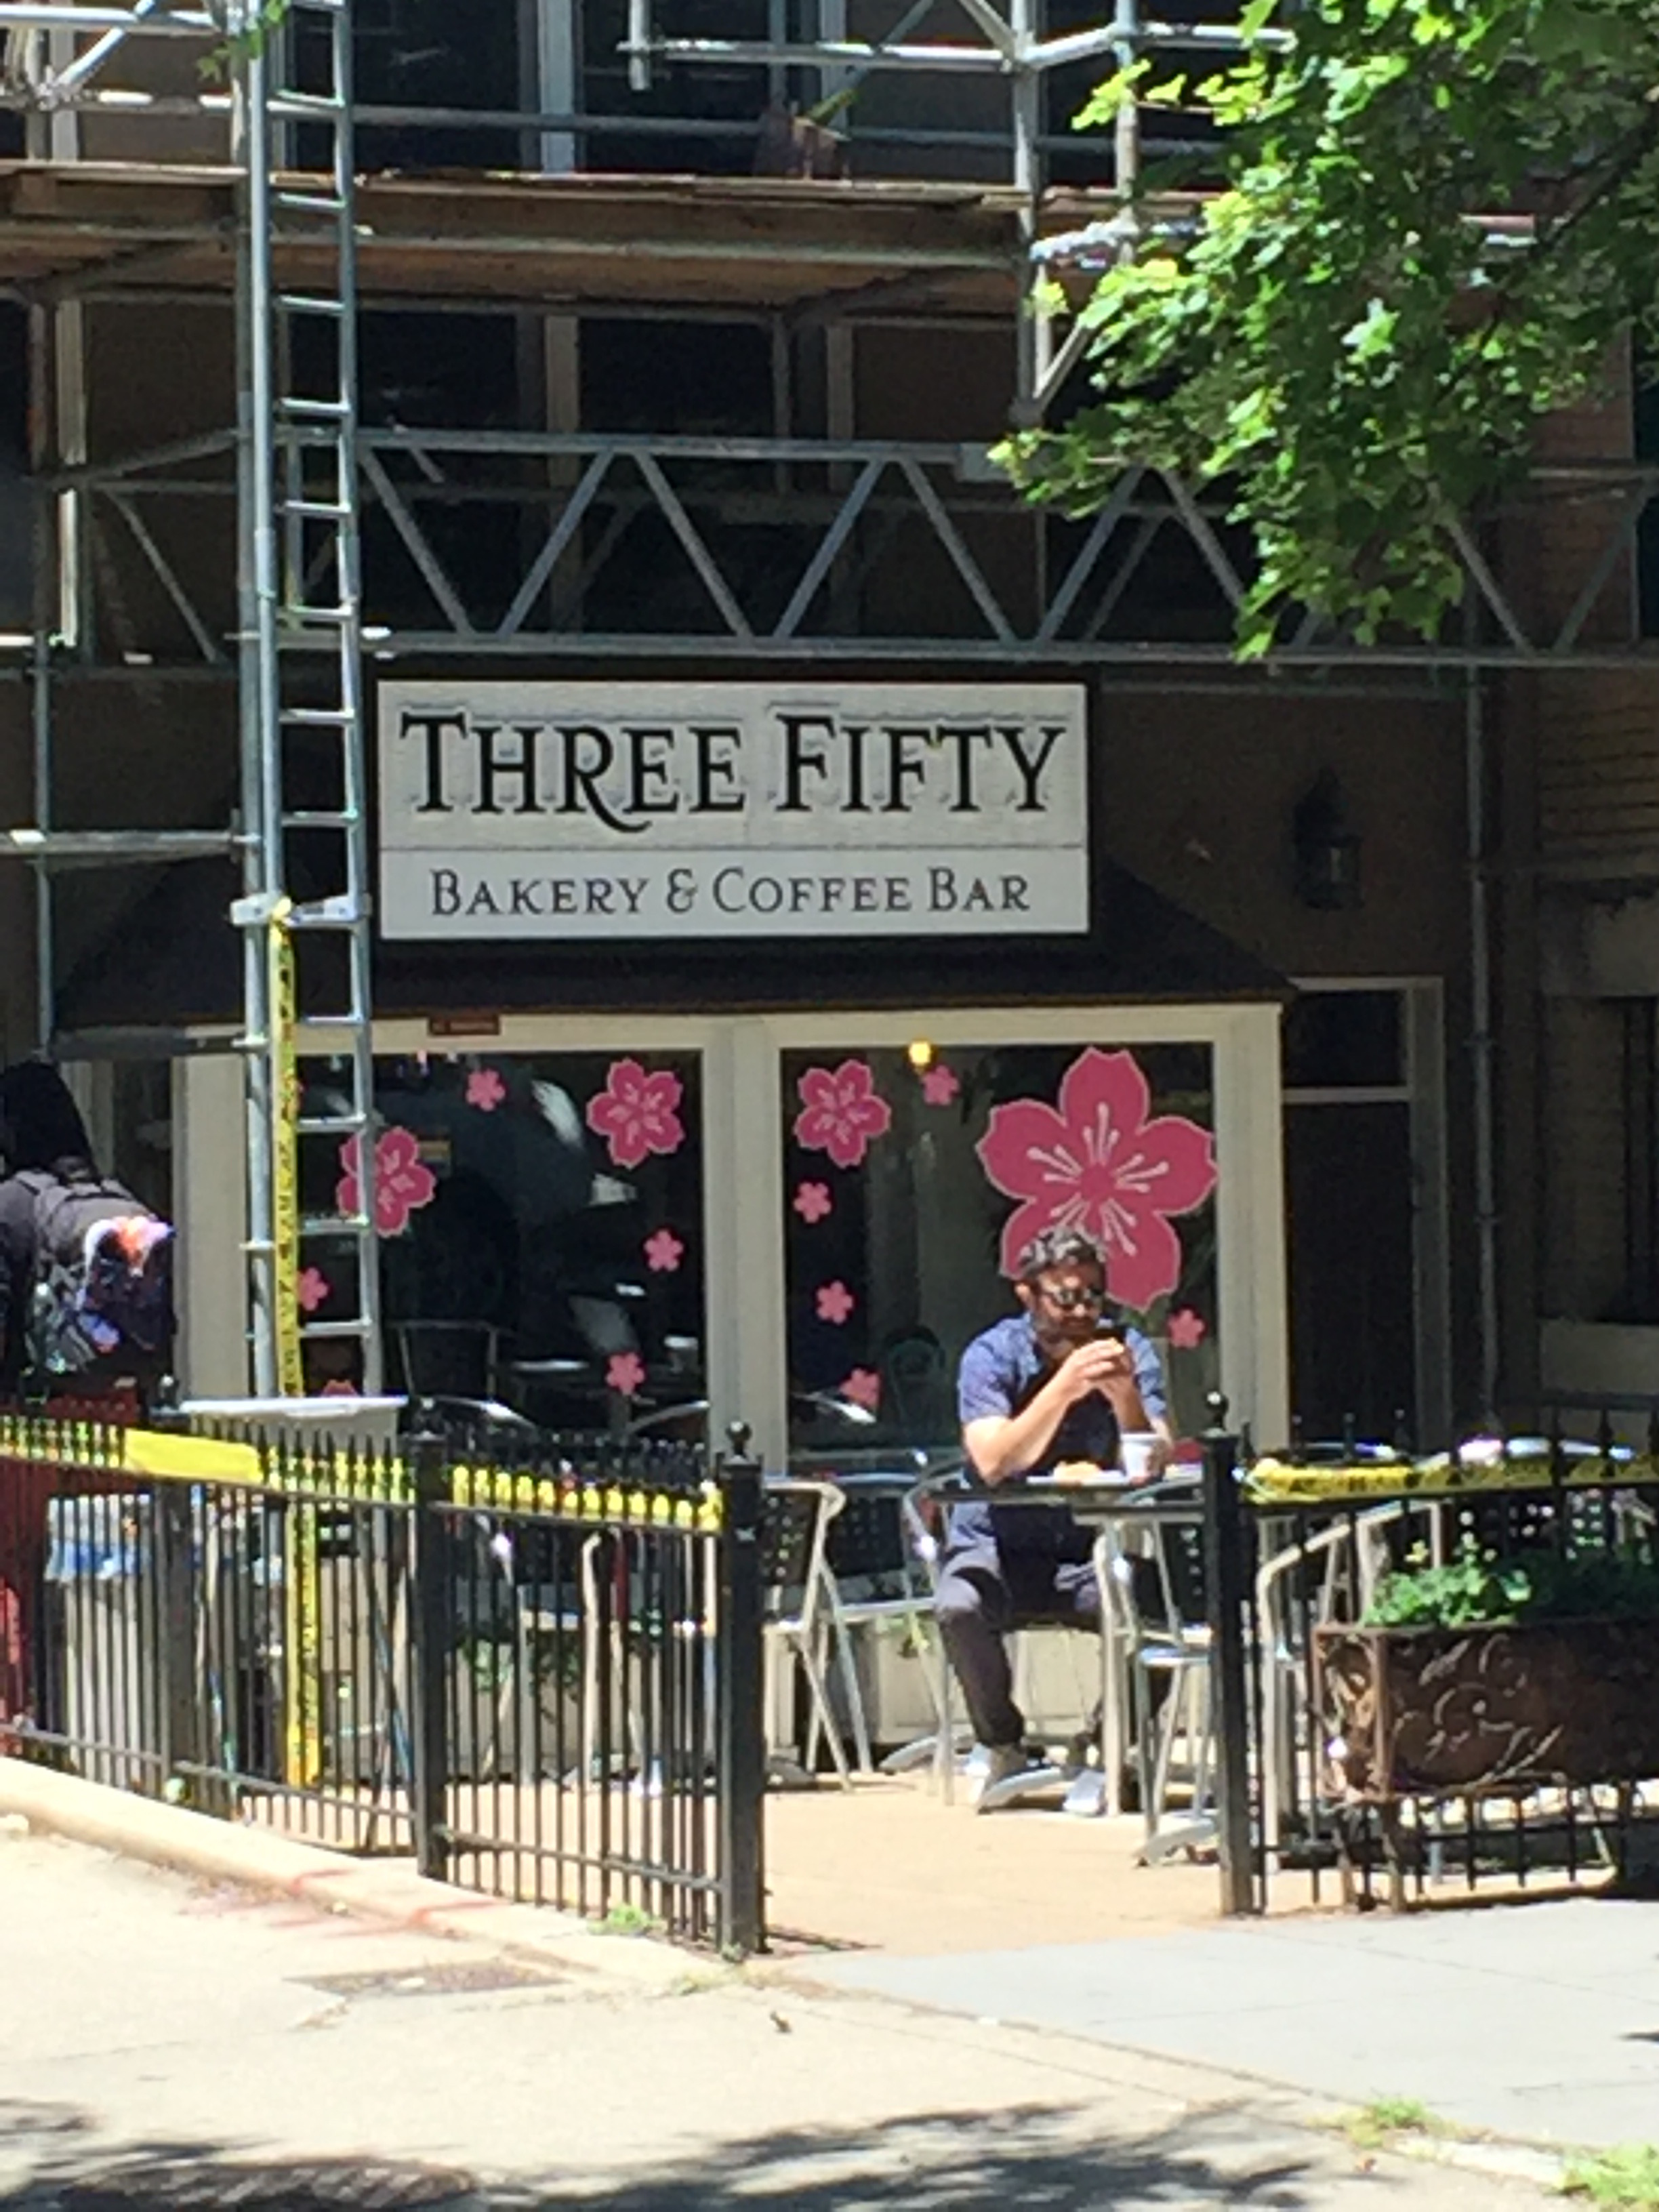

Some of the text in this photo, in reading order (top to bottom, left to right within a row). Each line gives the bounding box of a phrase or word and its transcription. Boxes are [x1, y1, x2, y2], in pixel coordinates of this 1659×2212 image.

[400, 712, 1066, 833] THREE FIFTY
[430, 867, 1030, 917] BAKERY & COFFEE BAR
